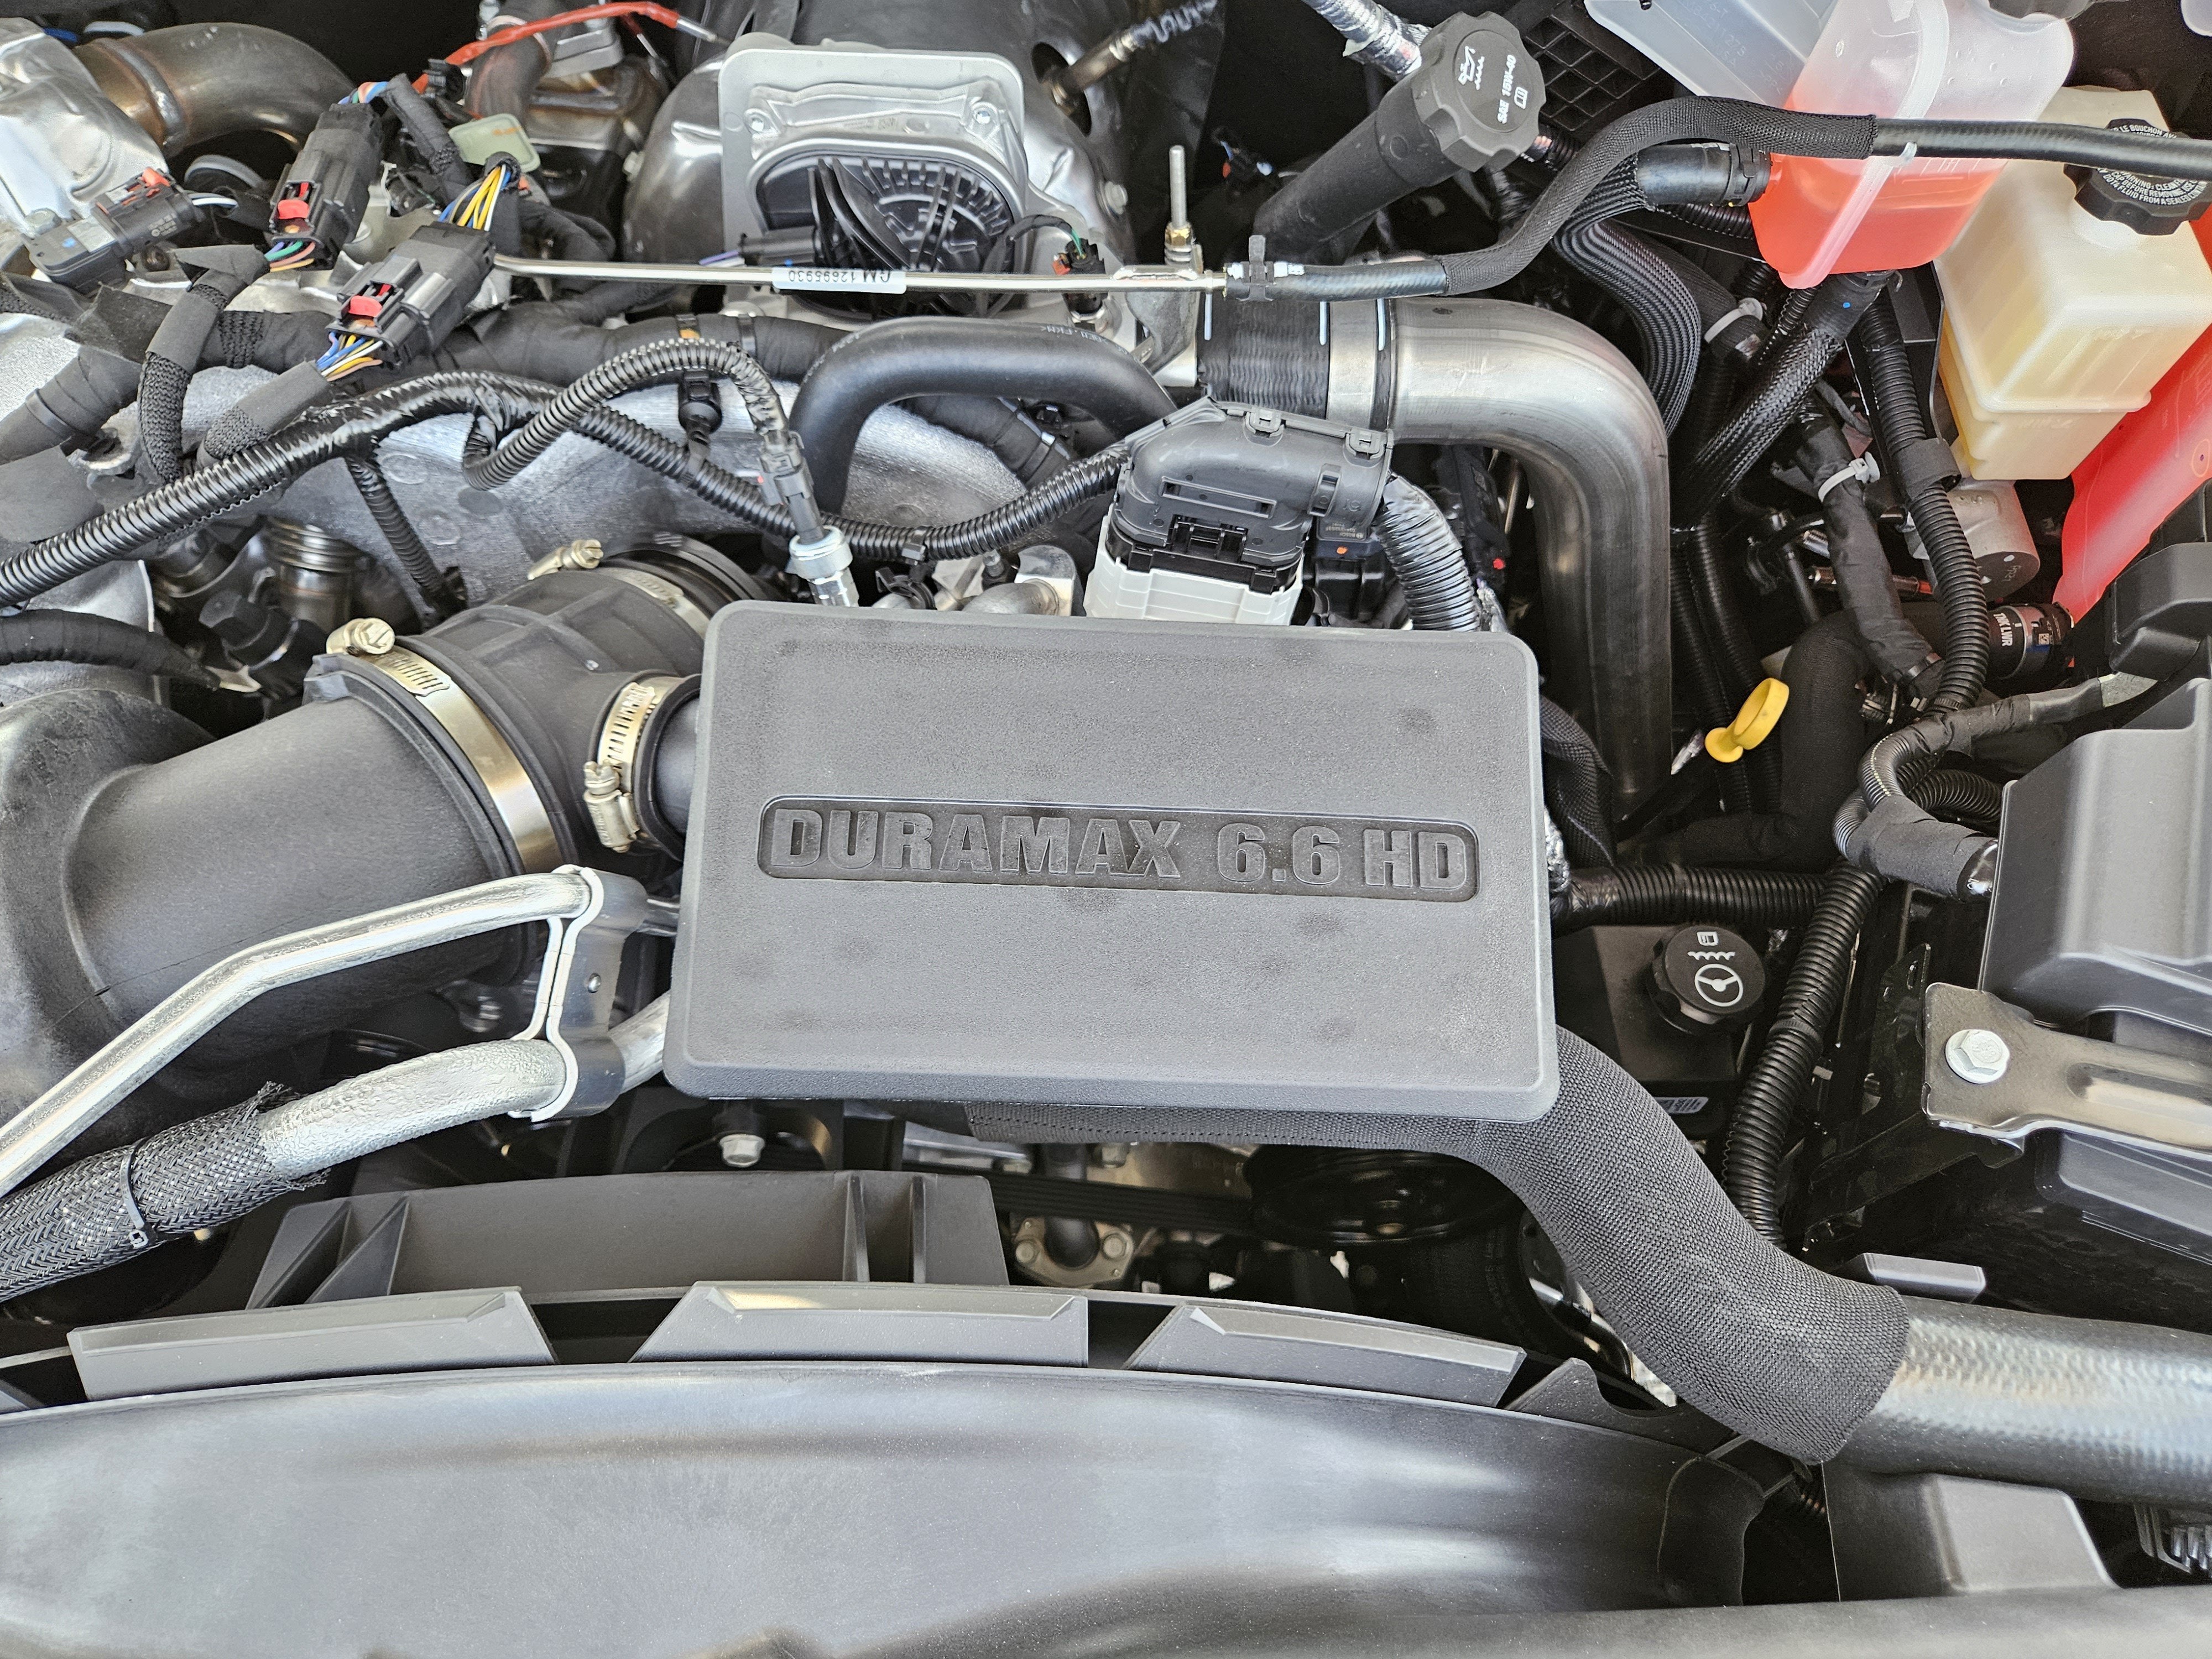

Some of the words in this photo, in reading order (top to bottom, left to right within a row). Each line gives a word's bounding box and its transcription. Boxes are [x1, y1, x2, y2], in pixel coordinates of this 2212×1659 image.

[1501, 54, 1516, 97] 15W-40
[1496, 100, 1510, 124] SAE
[2129, 124, 2162, 136] BOUCHON
[2117, 185, 2139, 199] FLUID
[2138, 194, 2160, 205] FROM
[2166, 194, 2192, 205] SEALED
[2122, 180, 2149, 195] BEFORE
[789, 270, 856, 283] 12695930
[863, 269, 891, 283] GM
[2000, 627, 2013, 646] LWR
[771, 808, 1181, 879] DURAMAX
[1218, 822, 1340, 885] 6.6
[1364, 829, 1467, 890] HD
